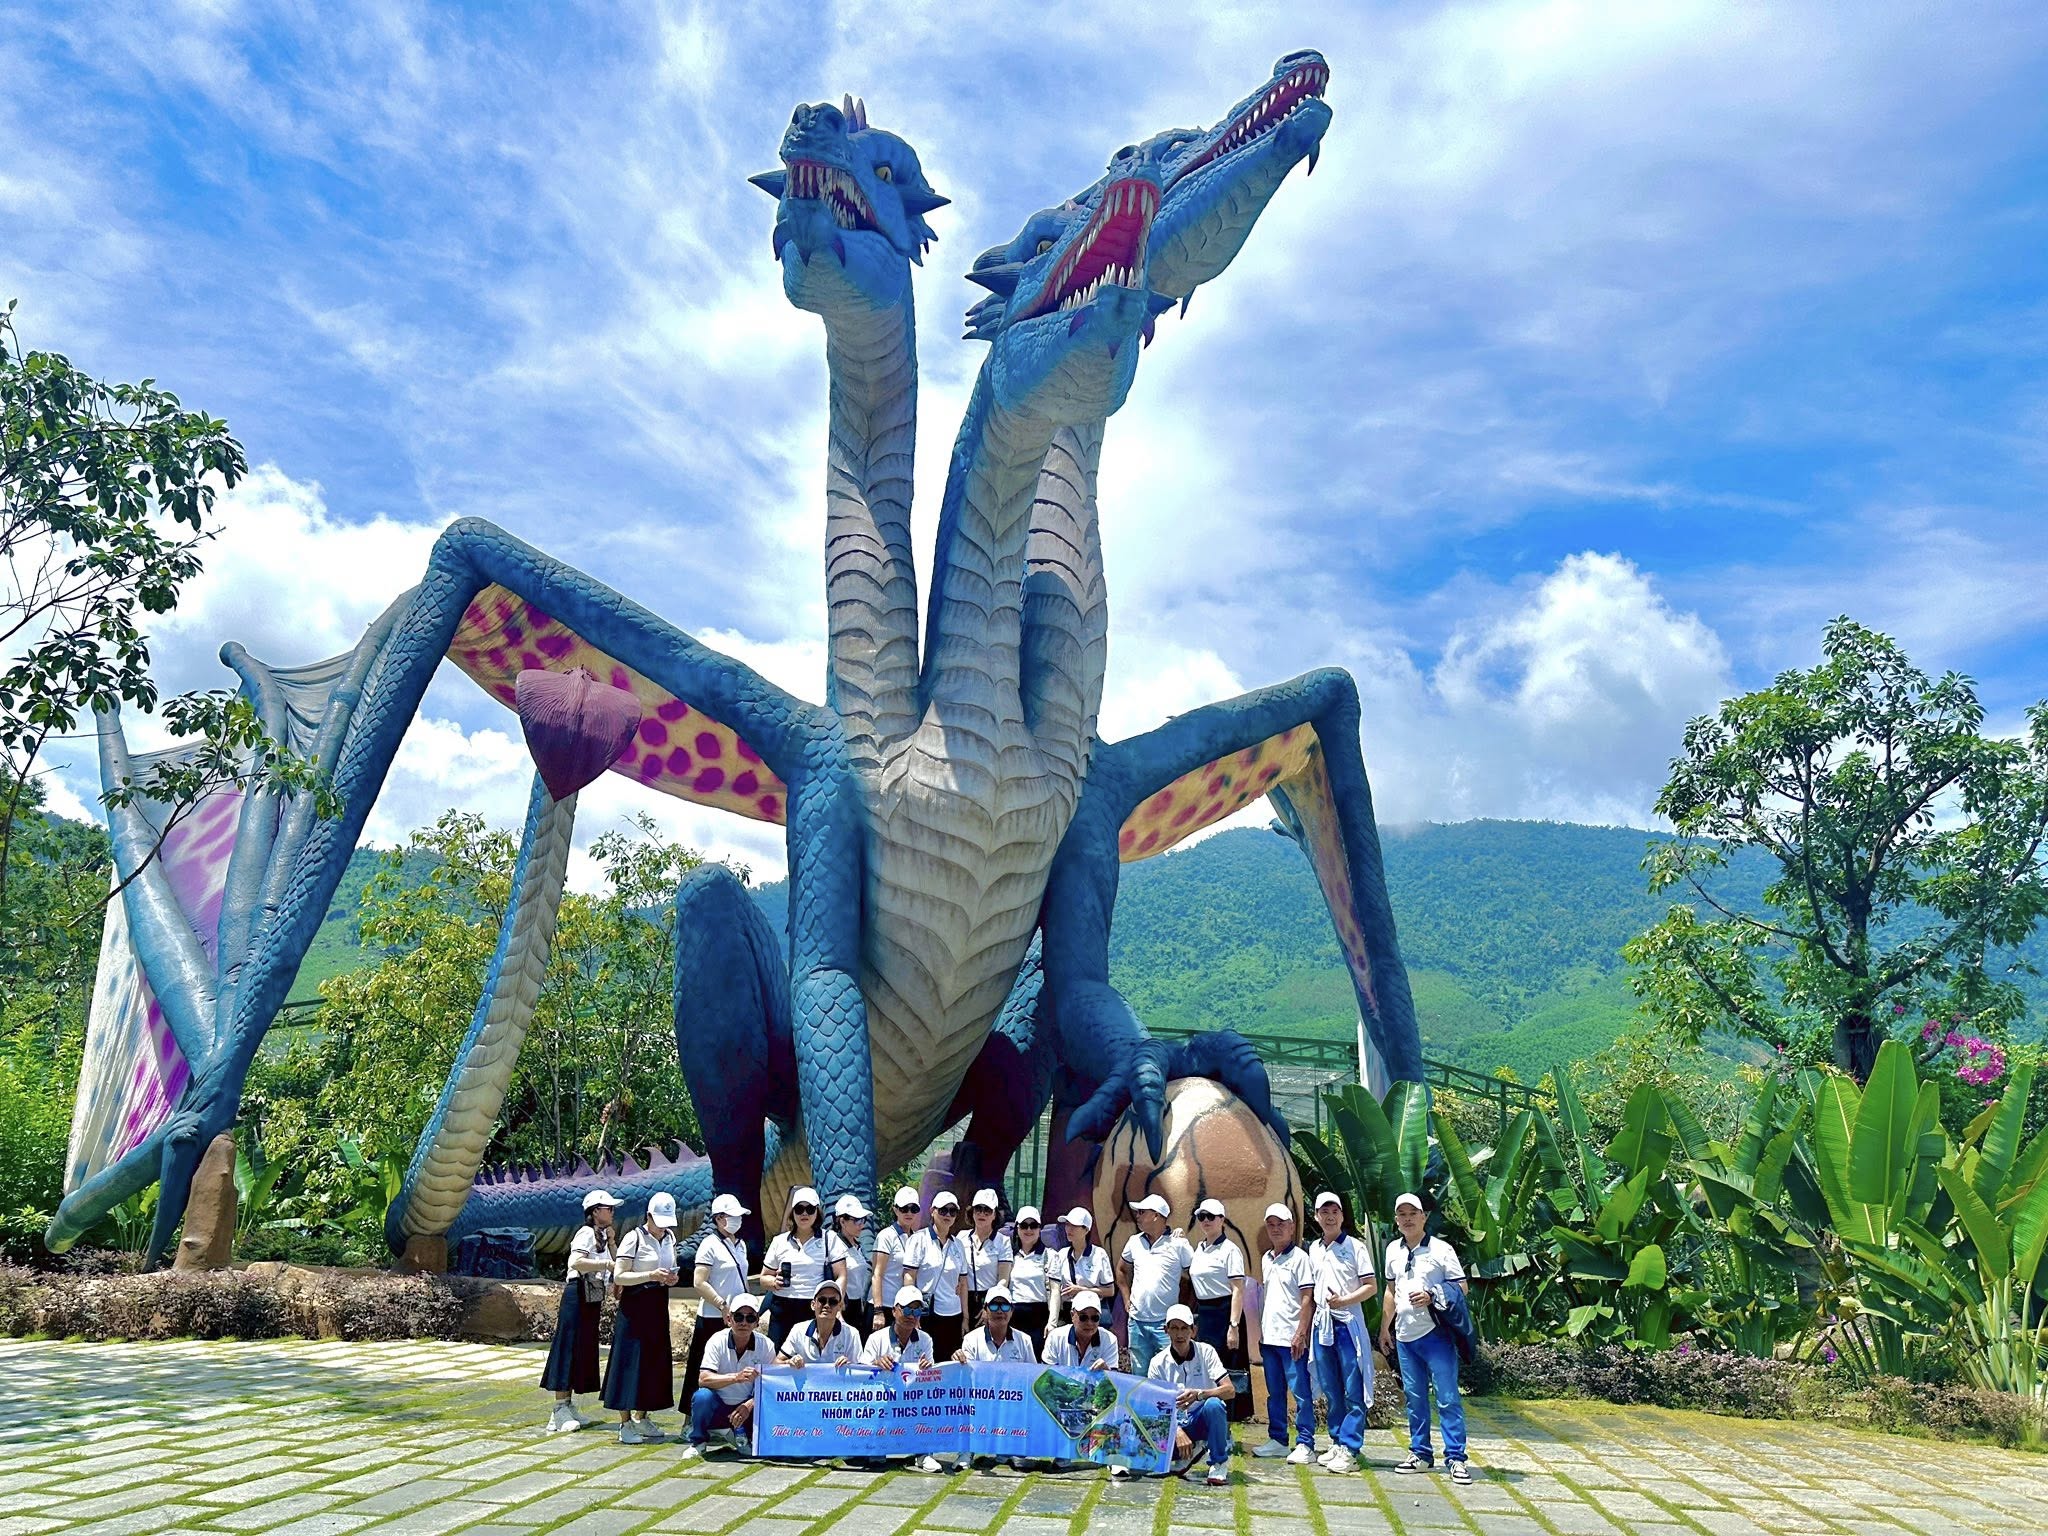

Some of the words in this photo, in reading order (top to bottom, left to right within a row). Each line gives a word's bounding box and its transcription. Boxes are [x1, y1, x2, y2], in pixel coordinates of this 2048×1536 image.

[777, 1391, 805, 1402] NANO
[808, 1391, 843, 1402] TRAVEL
[846, 1389, 873, 1402] CHÀO
[876, 1388, 897, 1401] ĐÓN
[903, 1390, 923, 1402] HỌP
[927, 1386, 946, 1400] LỚP
[949, 1386, 965, 1401] HỘI
[969, 1387, 995, 1400] KHOÁ
[998, 1390, 1023, 1401] 2025
[822, 1406, 852, 1418] NHÓM
[855, 1404, 875, 1418] CẤP
[892, 1407, 917, 1418] THCS
[921, 1406, 941, 1417] CAO
